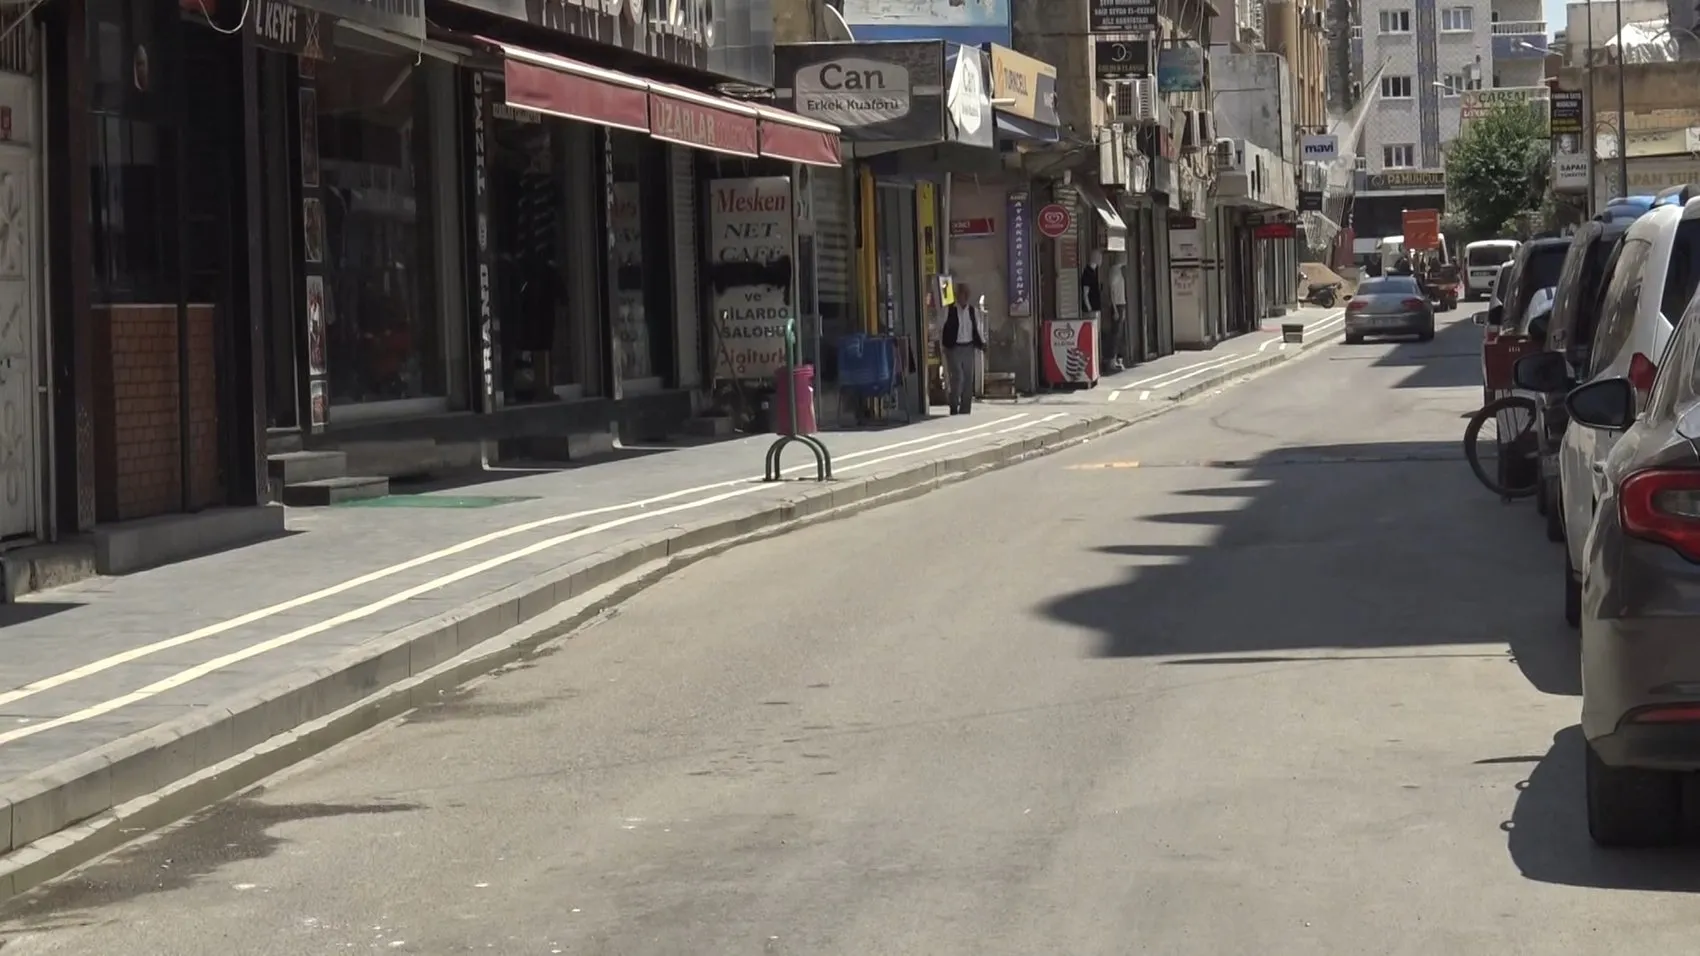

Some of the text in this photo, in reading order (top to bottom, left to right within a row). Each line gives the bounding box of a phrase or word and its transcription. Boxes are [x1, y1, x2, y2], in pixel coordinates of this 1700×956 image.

[818, 62, 886, 91] Can
[804, 99, 843, 112] Erkek
[1304, 140, 1334, 154] mavi
[716, 186, 786, 213] Mesken
[744, 292, 761, 302] ve
